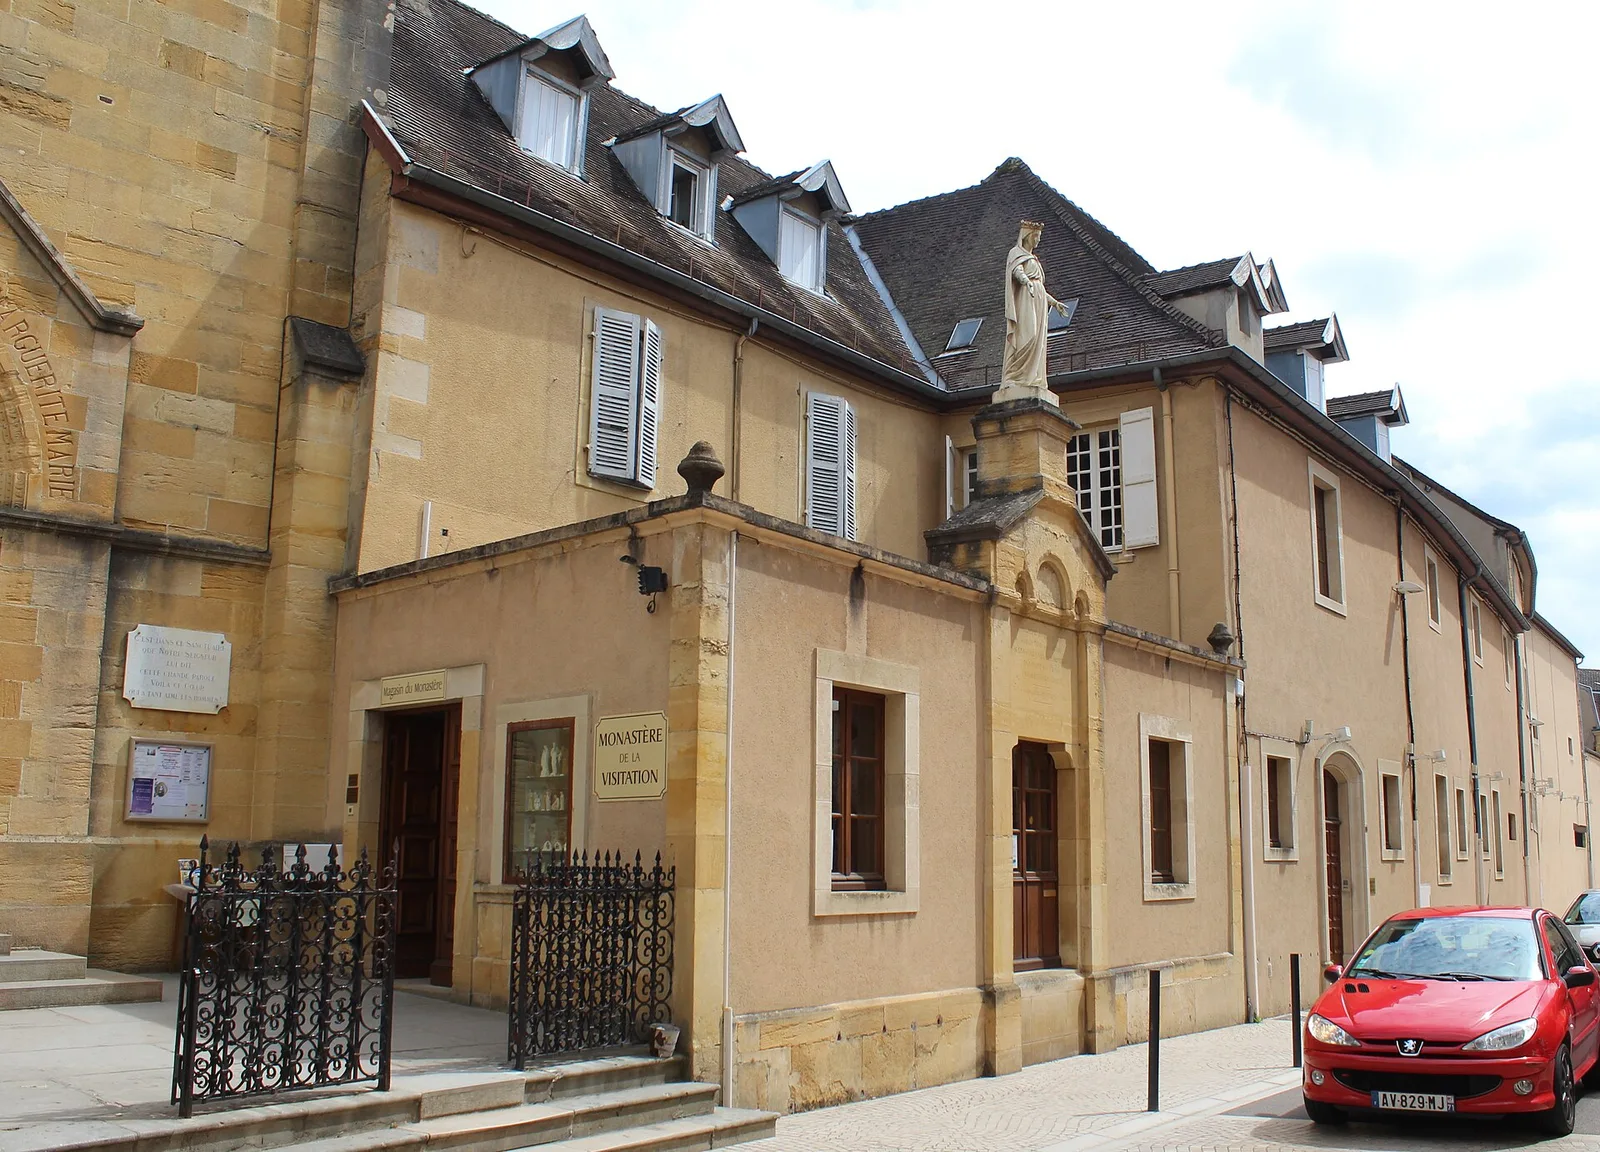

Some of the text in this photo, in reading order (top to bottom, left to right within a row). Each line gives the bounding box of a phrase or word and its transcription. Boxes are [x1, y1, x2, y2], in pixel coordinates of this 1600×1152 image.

[0, 297, 76, 500] ARGUERITE MARIE
[383, 680, 443, 700] Magasin du Monastère
[599, 724, 663, 747] MONASTÈRE
[619, 752, 641, 764] DE LA
[601, 769, 659, 786] VISITATION
